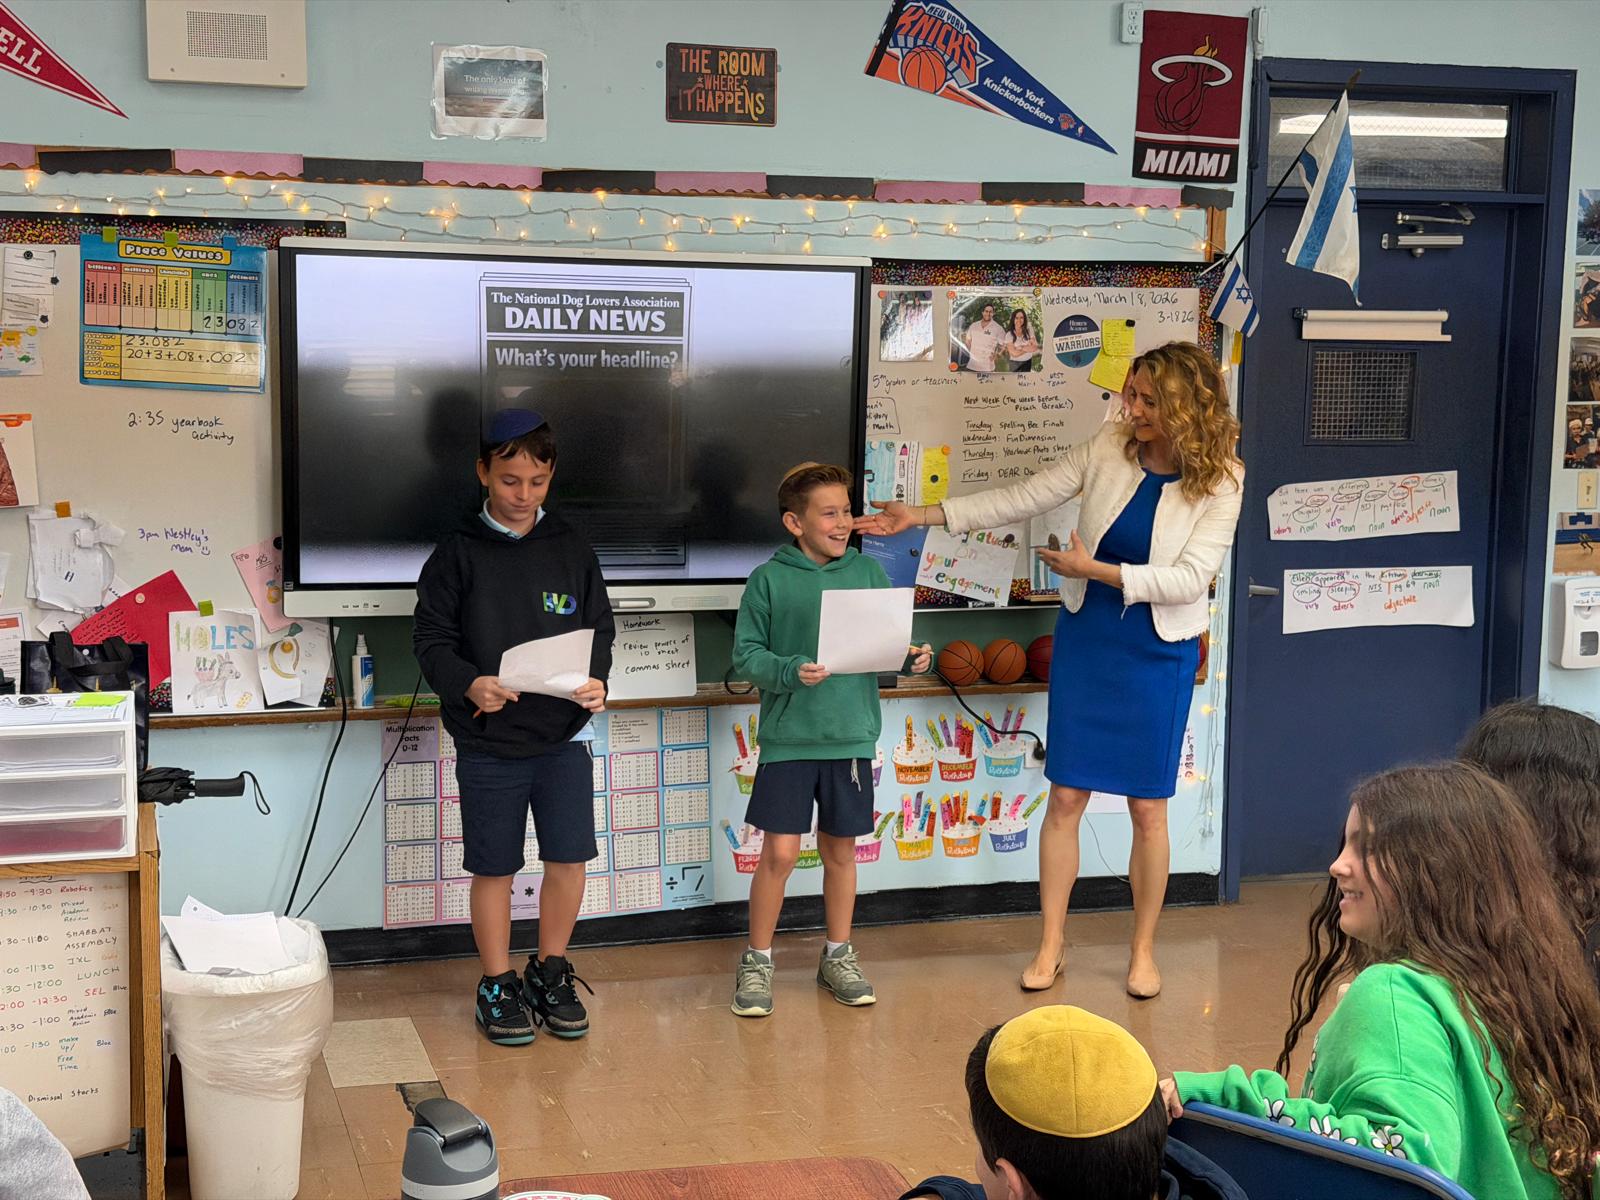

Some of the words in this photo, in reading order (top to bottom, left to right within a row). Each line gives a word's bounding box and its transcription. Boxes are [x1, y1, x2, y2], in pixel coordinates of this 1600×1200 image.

[927, 4, 947, 21] NEW
[946, 13, 966, 32] YORK
[895, 5, 978, 73] KNICKS
[680, 49, 711, 73] THE
[719, 51, 765, 76] ROOM
[704, 75, 741, 91] WHERE
[1001, 75, 1023, 93] New
[1025, 88, 1046, 107] York
[696, 85, 765, 121] HAPPENS
[983, 77, 1055, 124] Knickerbockers
[1141, 149, 1231, 177] MIAMI
[126, 244, 166, 256] Place
[173, 248, 223, 260] Values
[491, 292, 512, 304] The
[515, 293, 560, 305] National
[563, 294, 583, 307] Dog
[586, 295, 620, 307] Lovers
[622, 296, 680, 308] Association
[1094, 292, 1126, 304] March
[1150, 292, 1178, 304] 2026
[505, 307, 584, 330] DAILY
[589, 309, 666, 332] NEWS
[126, 336, 184, 347] 23.082
[1055, 337, 1100, 352] WARRIORS
[495, 348, 555, 367] What's
[559, 352, 597, 371] your
[601, 350, 678, 369] headline?
[172, 416, 224, 433] yearbook
[998, 467, 1020, 478] DEAR
[923, 552, 958, 571] your
[623, 618, 661, 630] Homework
[176, 621, 256, 652] HOLES
[666, 660, 690, 671] sheet
[66, 927, 112, 938] SHABBAT
[65, 936, 117, 950] ASSEMBLY
[77, 966, 120, 981] LUNCH
[84, 987, 106, 997] SEL
